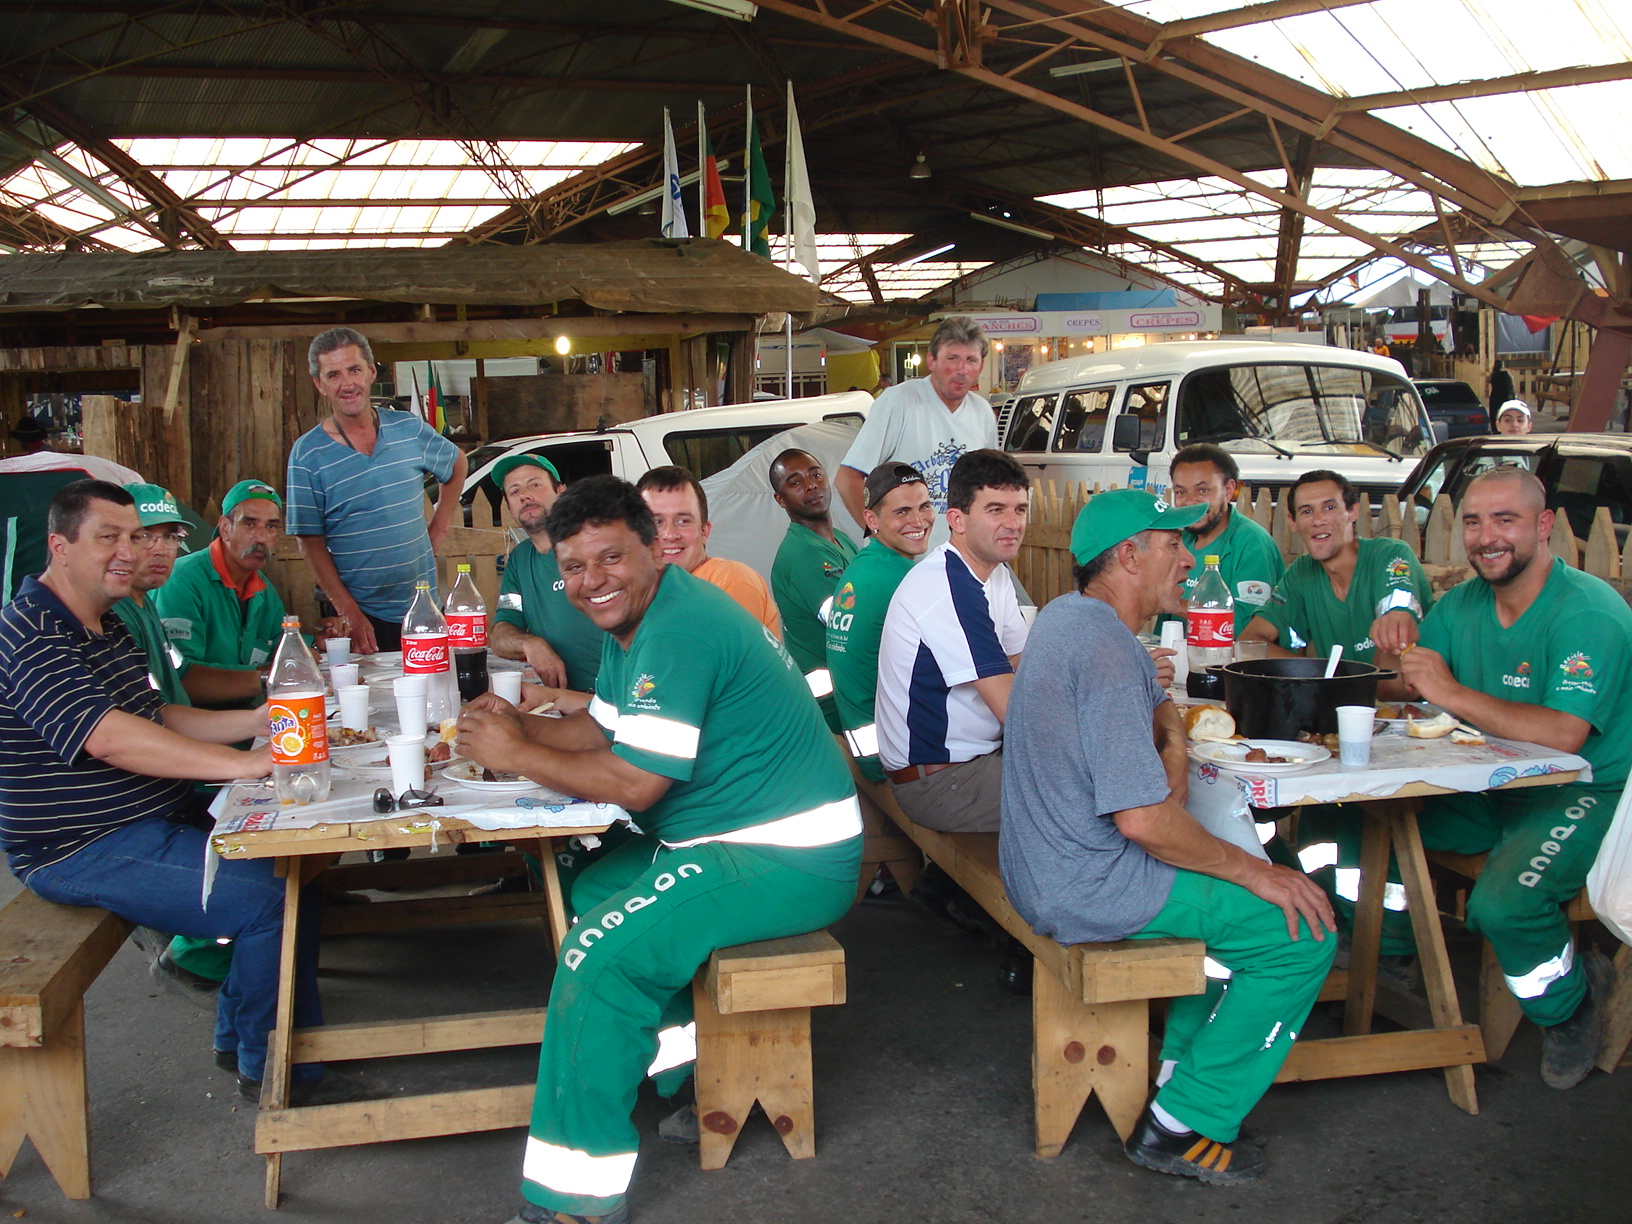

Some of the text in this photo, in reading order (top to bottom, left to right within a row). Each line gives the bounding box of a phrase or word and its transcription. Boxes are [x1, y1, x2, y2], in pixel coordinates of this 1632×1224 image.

[982, 322, 1033, 330] ANCHES
[1067, 318, 1100, 327] CREPES
[1517, 796, 1598, 888] codeca
[564, 863, 703, 972] codeca
